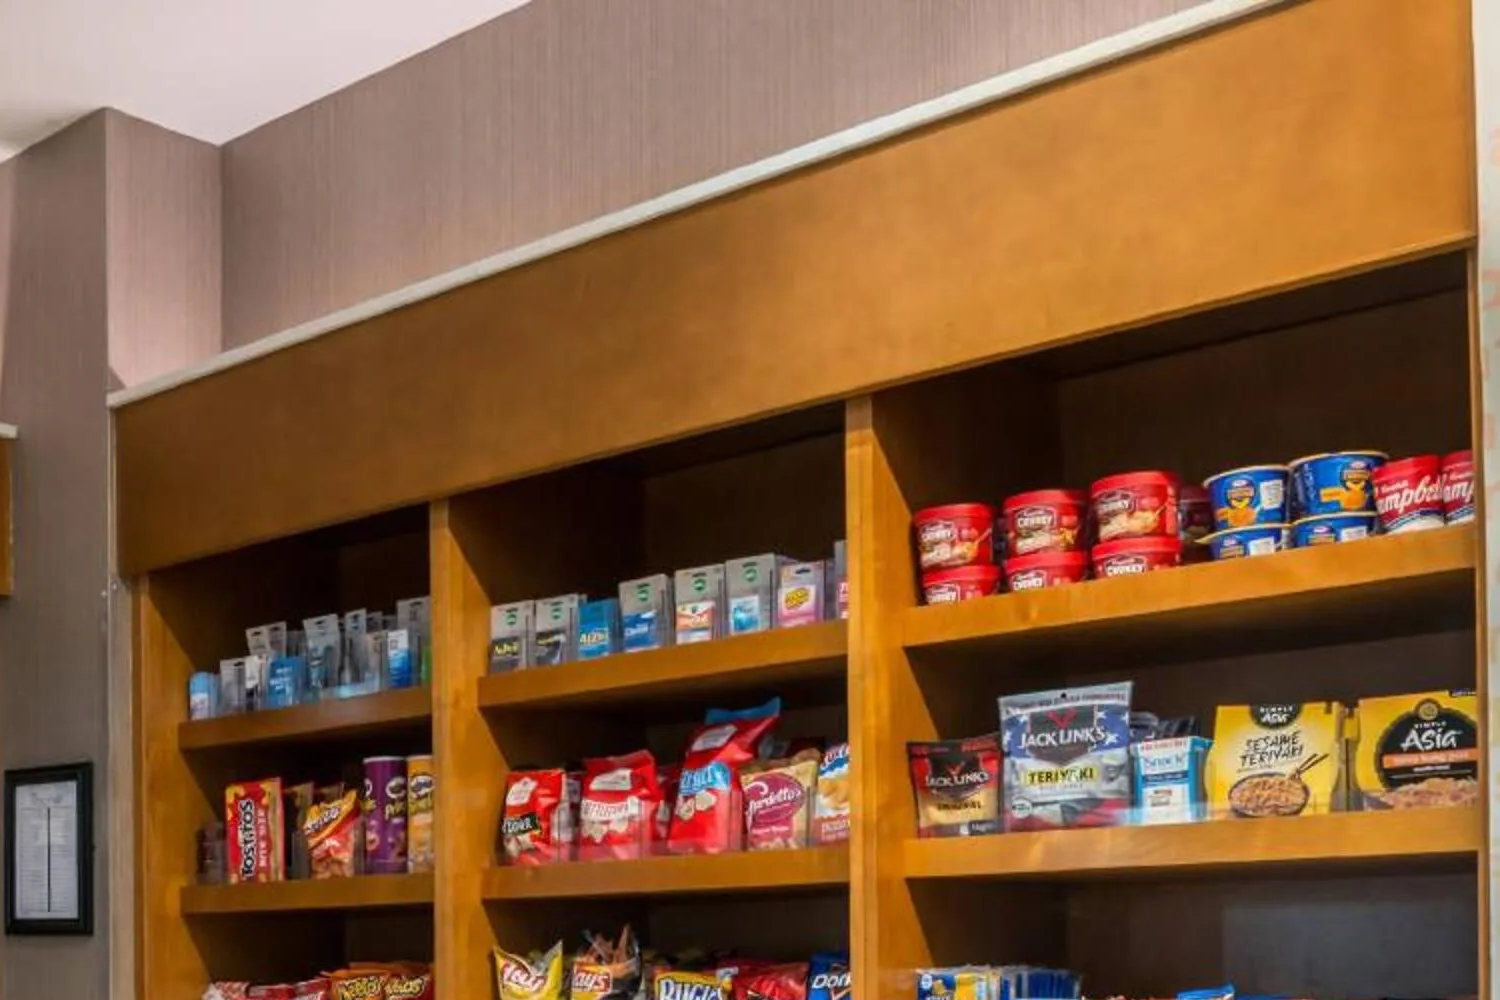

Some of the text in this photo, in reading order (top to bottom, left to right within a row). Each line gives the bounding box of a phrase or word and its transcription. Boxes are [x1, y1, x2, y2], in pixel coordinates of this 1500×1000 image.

[1021, 726, 1106, 748] JACK LINK'S
[1247, 731, 1300, 752] SESAME
[1401, 730, 1459, 751] Asia
[1240, 747, 1303, 767] TERIYAKI
[926, 776, 952, 787] JACK
[1029, 767, 1094, 785] TERIYAKI
[239, 801, 255, 878] TOSTITOS
